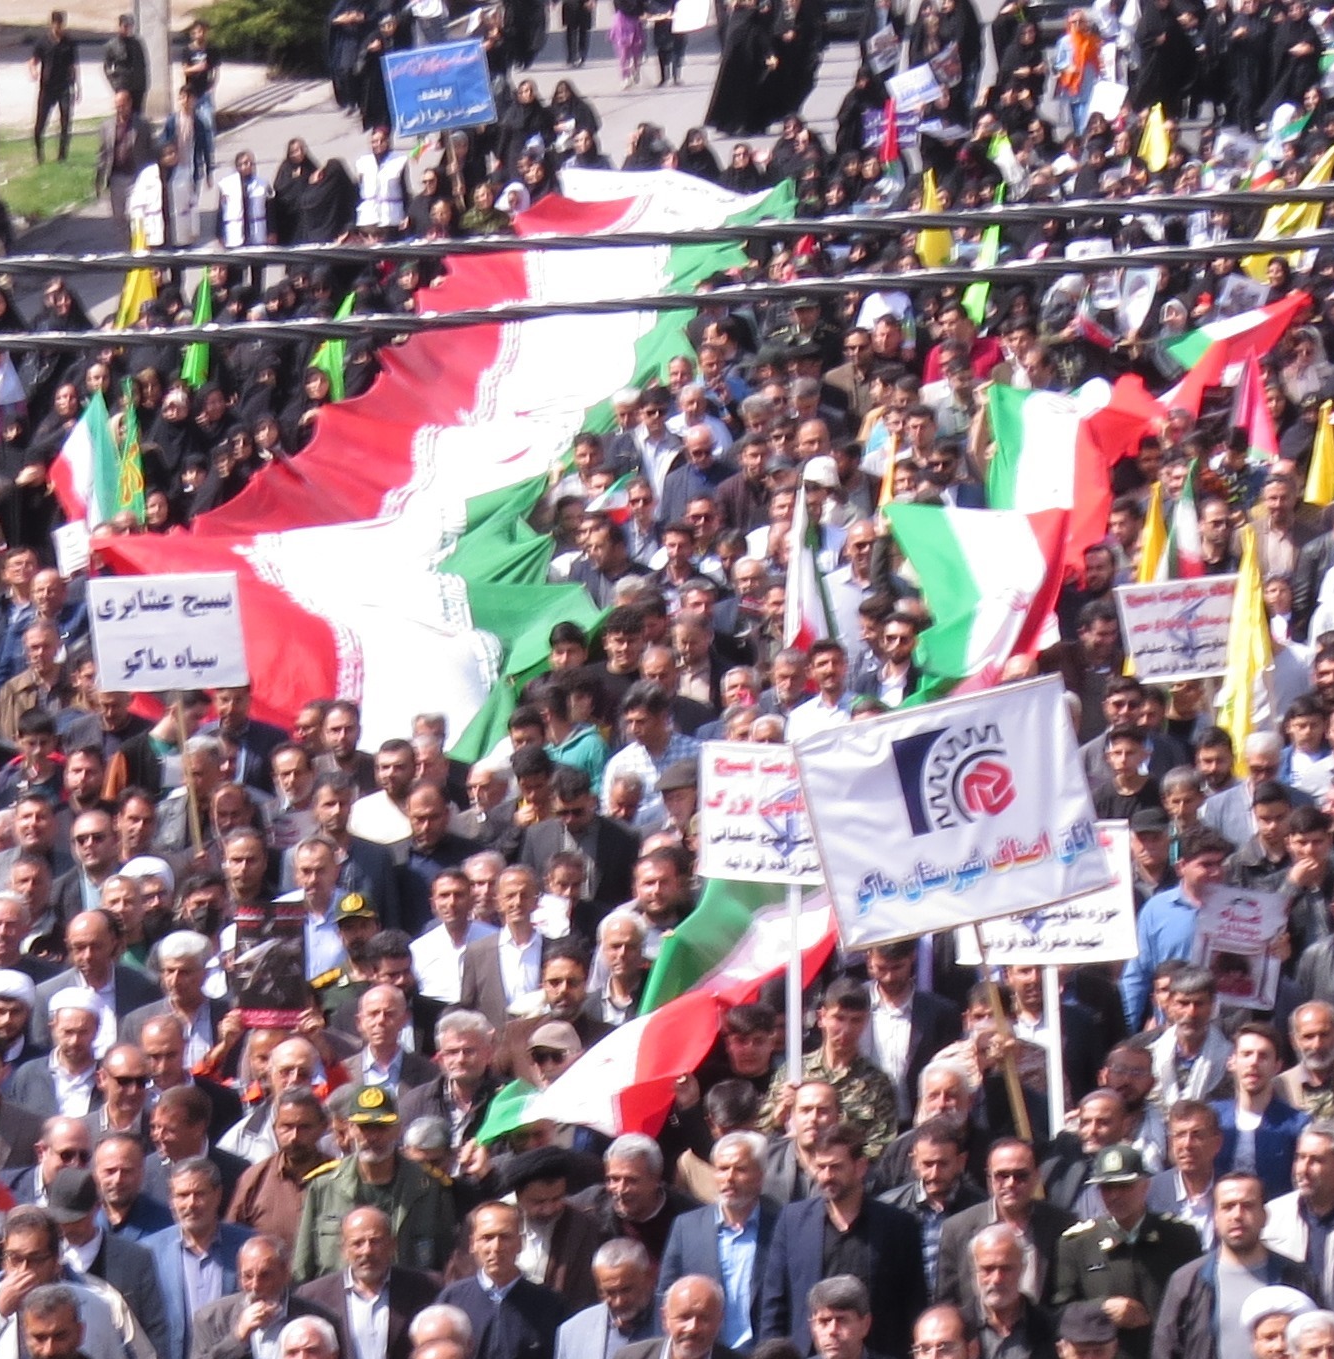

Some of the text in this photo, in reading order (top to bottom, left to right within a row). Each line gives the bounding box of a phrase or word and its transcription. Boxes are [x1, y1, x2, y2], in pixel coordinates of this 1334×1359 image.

[97, 588, 234, 621] بسیج عشایری
[123, 646, 219, 680] سپاه ماکو
[714, 757, 754, 777] بسیج
[710, 826, 755, 845] عملیاتی
[990, 830, 1053, 873] اصناف
[1056, 819, 1096, 865] اتاق
[901, 848, 987, 903] شهرستان
[855, 870, 900, 917] ماکو
[1074, 931, 1105, 949] شهید
